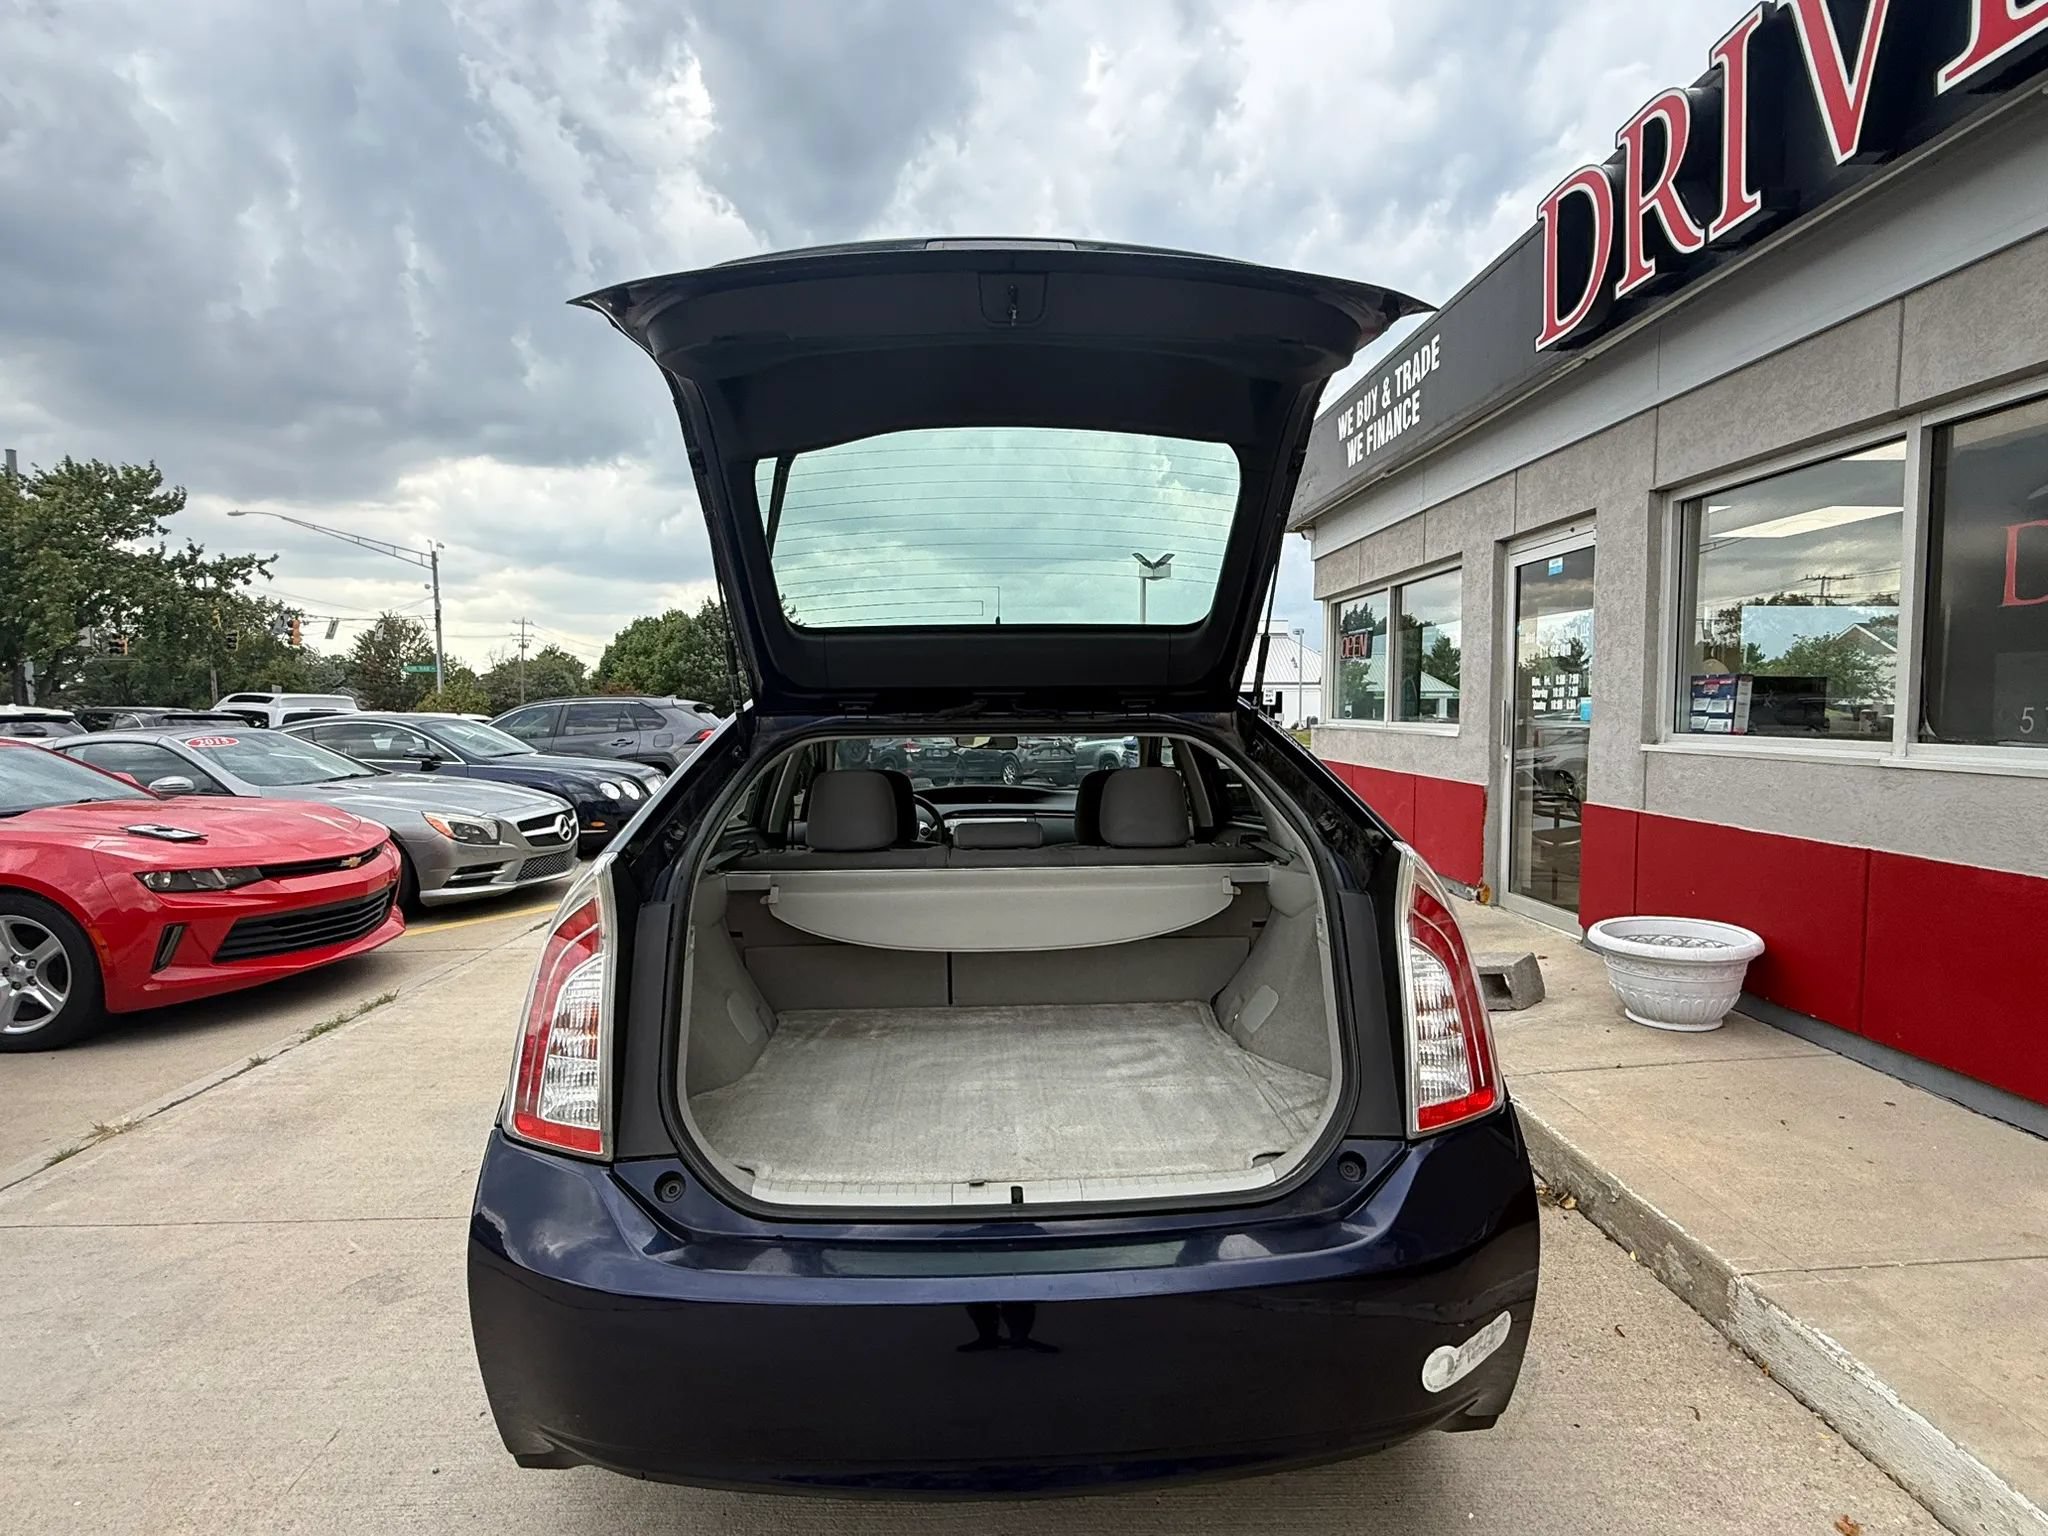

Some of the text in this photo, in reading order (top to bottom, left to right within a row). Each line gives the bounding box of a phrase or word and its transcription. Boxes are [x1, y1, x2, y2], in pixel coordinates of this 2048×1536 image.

[1338, 334, 1440, 441] WE BUY & TRADE
[1347, 389, 1420, 468] WE FINANCE
[1342, 633, 1368, 659] OPEN
